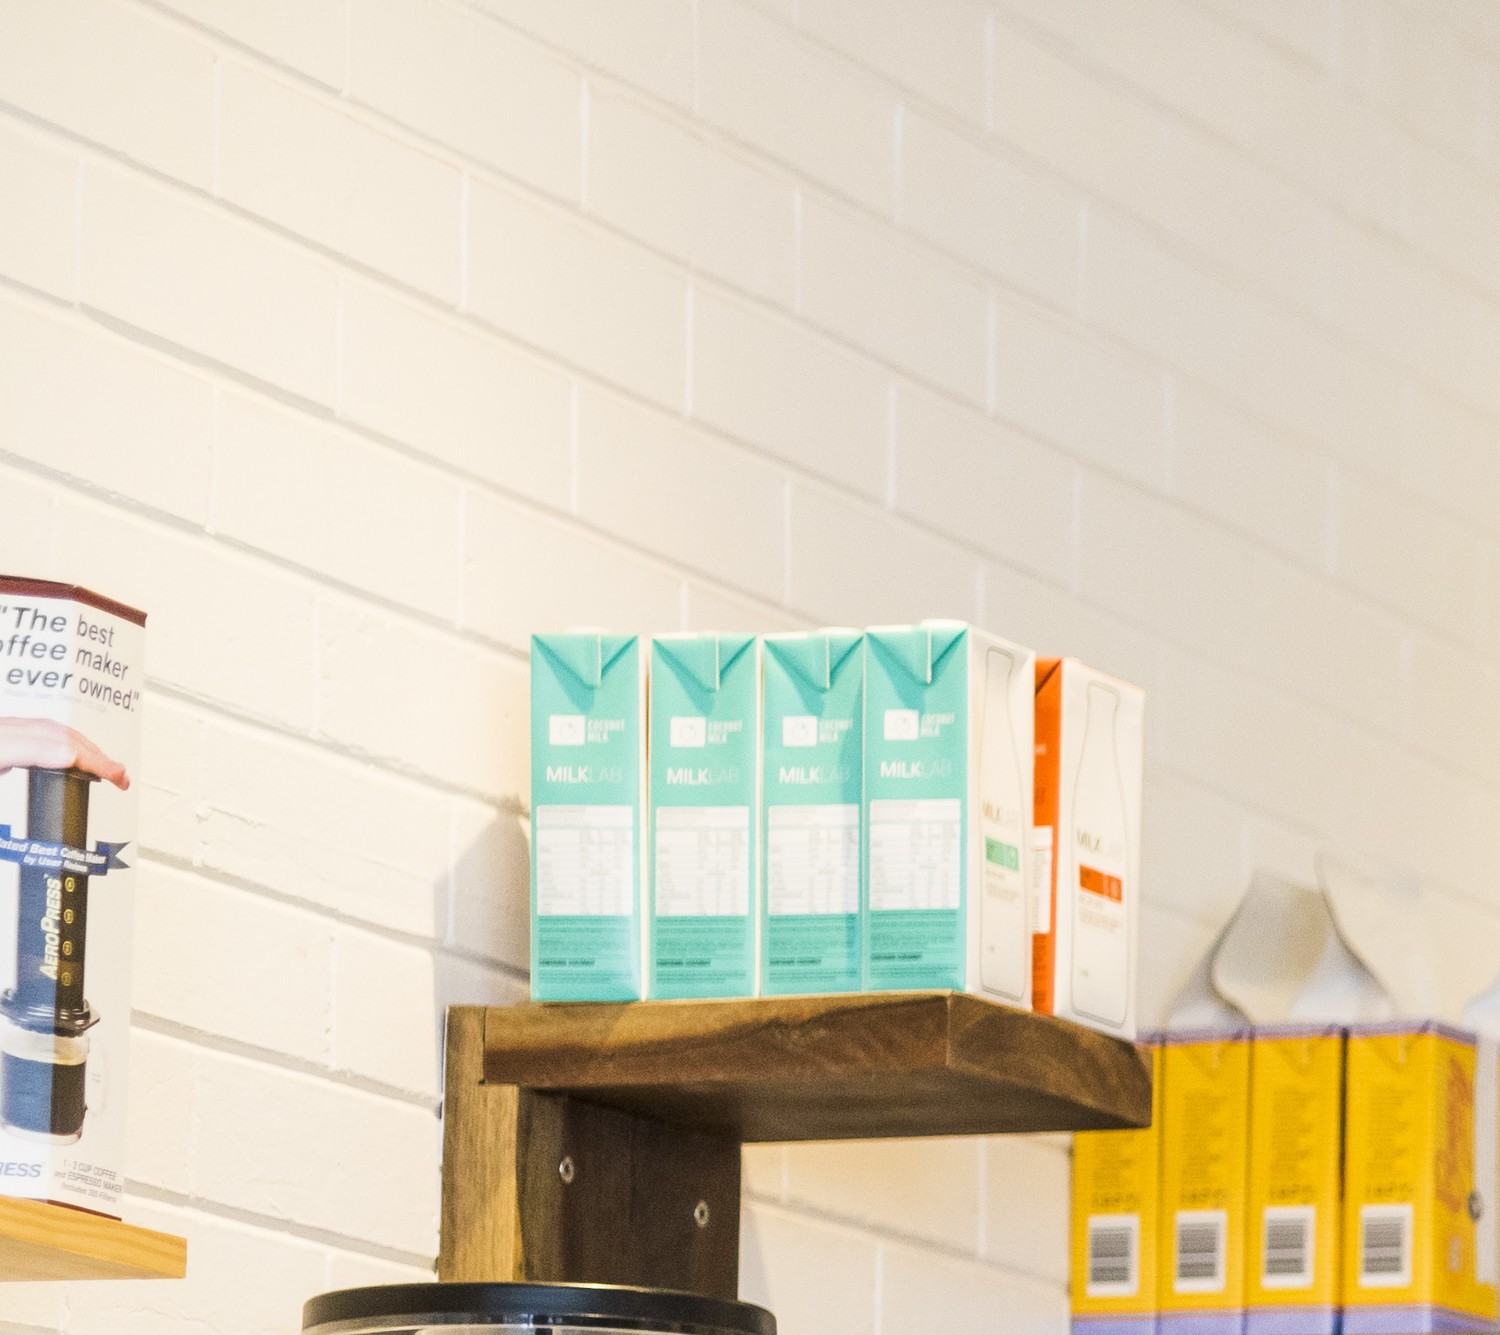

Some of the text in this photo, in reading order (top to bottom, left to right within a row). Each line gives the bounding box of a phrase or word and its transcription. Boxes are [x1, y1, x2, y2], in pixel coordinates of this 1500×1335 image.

[76, 614, 114, 647] best
[0, 634, 128, 680] ffee maker
[6, 668, 73, 689] ever
[93, 1166, 117, 1182] COFFEE
